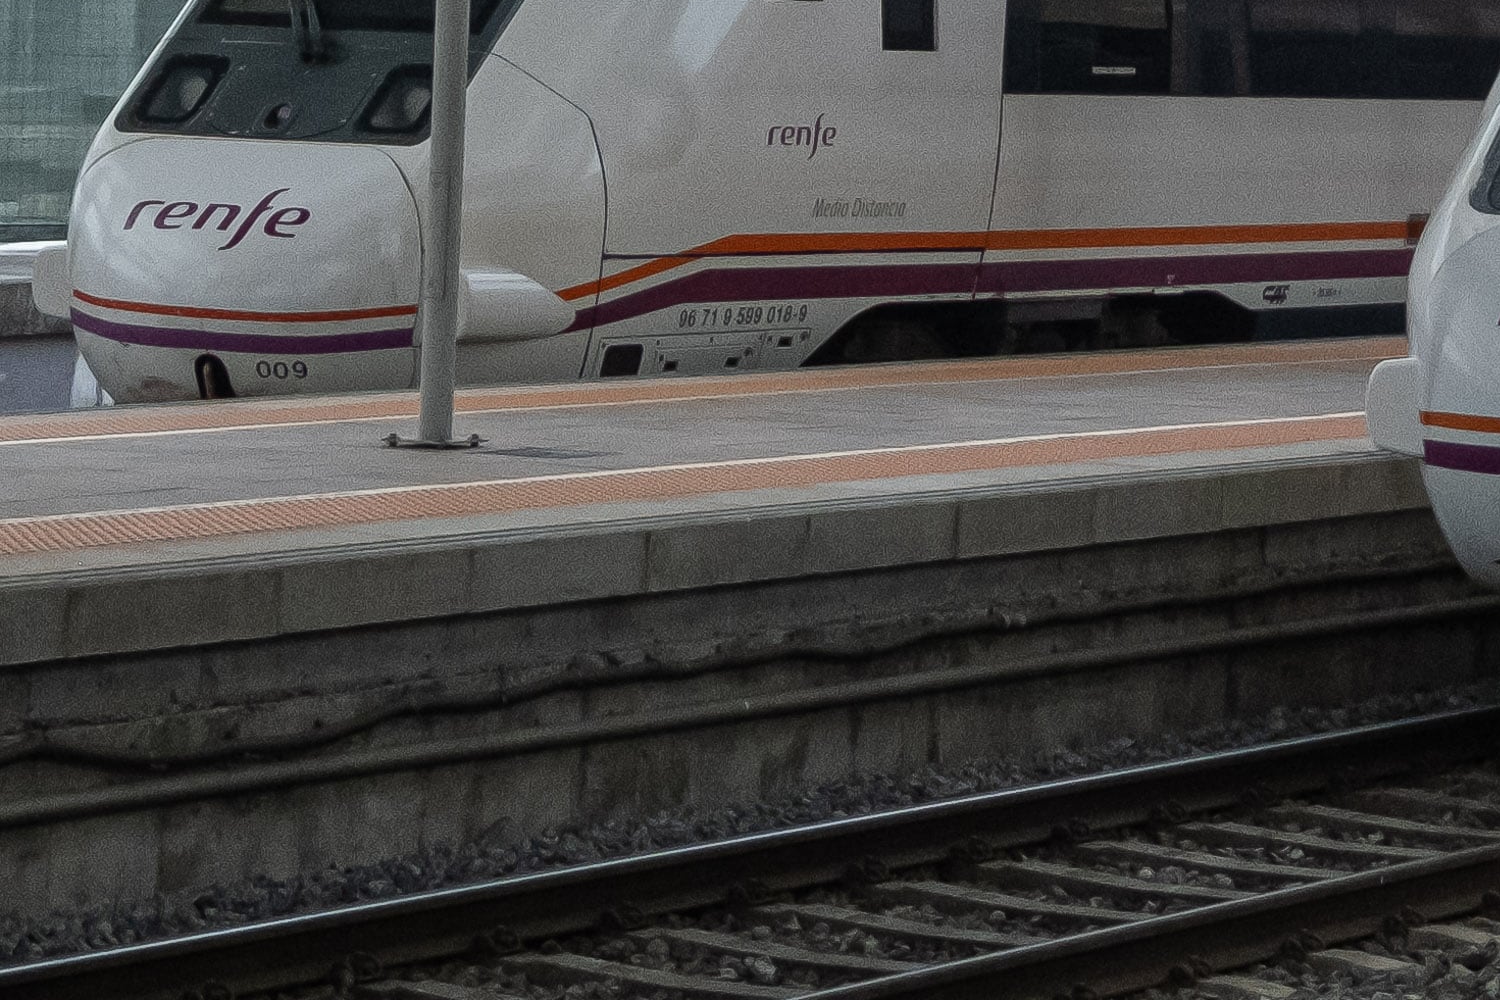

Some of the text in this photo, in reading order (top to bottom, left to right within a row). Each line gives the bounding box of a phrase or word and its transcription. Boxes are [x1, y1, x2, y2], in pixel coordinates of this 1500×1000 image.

[767, 113, 837, 161] renfe
[122, 187, 311, 251] renfe
[702, 308, 718, 326] 71
[255, 360, 309, 380] 009
